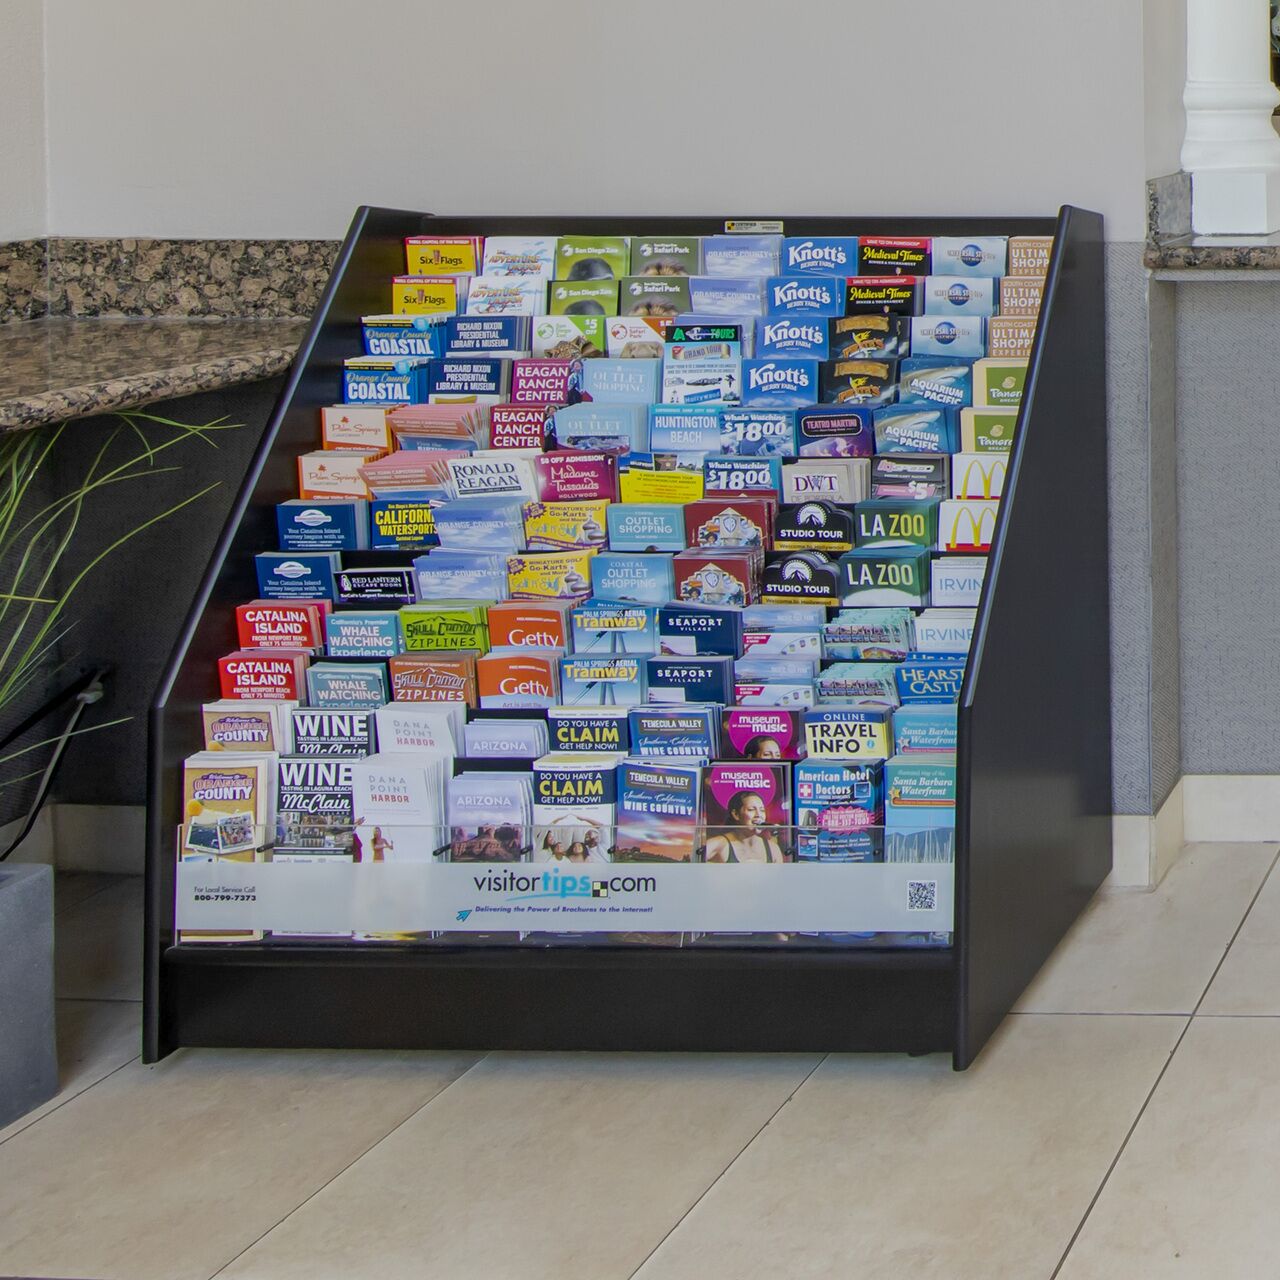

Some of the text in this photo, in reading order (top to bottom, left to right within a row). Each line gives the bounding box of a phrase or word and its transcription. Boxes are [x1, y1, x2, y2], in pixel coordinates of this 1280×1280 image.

[863, 247, 924, 261] Medieval Times
[420, 256, 463, 266] Six Flags
[369, 339, 434, 355] COASTAL
[517, 367, 568, 378] REAGAN
[750, 364, 808, 389] Knott's
[519, 380, 564, 390] RANCH
[911, 378, 963, 398] AQUARIUM
[516, 391, 564, 401] CENTER
[655, 417, 716, 428] HUNTINGTON
[670, 432, 702, 443] BEACH
[452, 462, 515, 477] RONALD
[551, 465, 598, 480] Madame
[456, 475, 520, 489] REAGAN
[554, 480, 599, 491] Tussauds
[625, 517, 664, 526] OUTLET
[860, 514, 925, 536] LA ZOO
[619, 526, 672, 534] SHOPPING
[781, 530, 843, 538] STUDIO TOUR
[246, 611, 307, 622] CATALINA
[574, 614, 648, 631] Tramway
[668, 618, 722, 627] SEAPORT
[255, 623, 302, 634] ISLAND
[341, 626, 379, 636] WHALE
[330, 636, 393, 646] WATCHING
[410, 637, 477, 648] ZIPLINES
[509, 629, 559, 648] Getty
[809, 724, 876, 737] TRAVEL
[813, 740, 860, 753] INFO
[735, 779, 770, 788] music
[893, 778, 953, 786] Santa Barbara
[540, 781, 603, 795] CLAIM
[901, 786, 946, 795] Waterfront
[194, 788, 252, 800] COUNTY
[457, 797, 511, 806] ARIZONA
